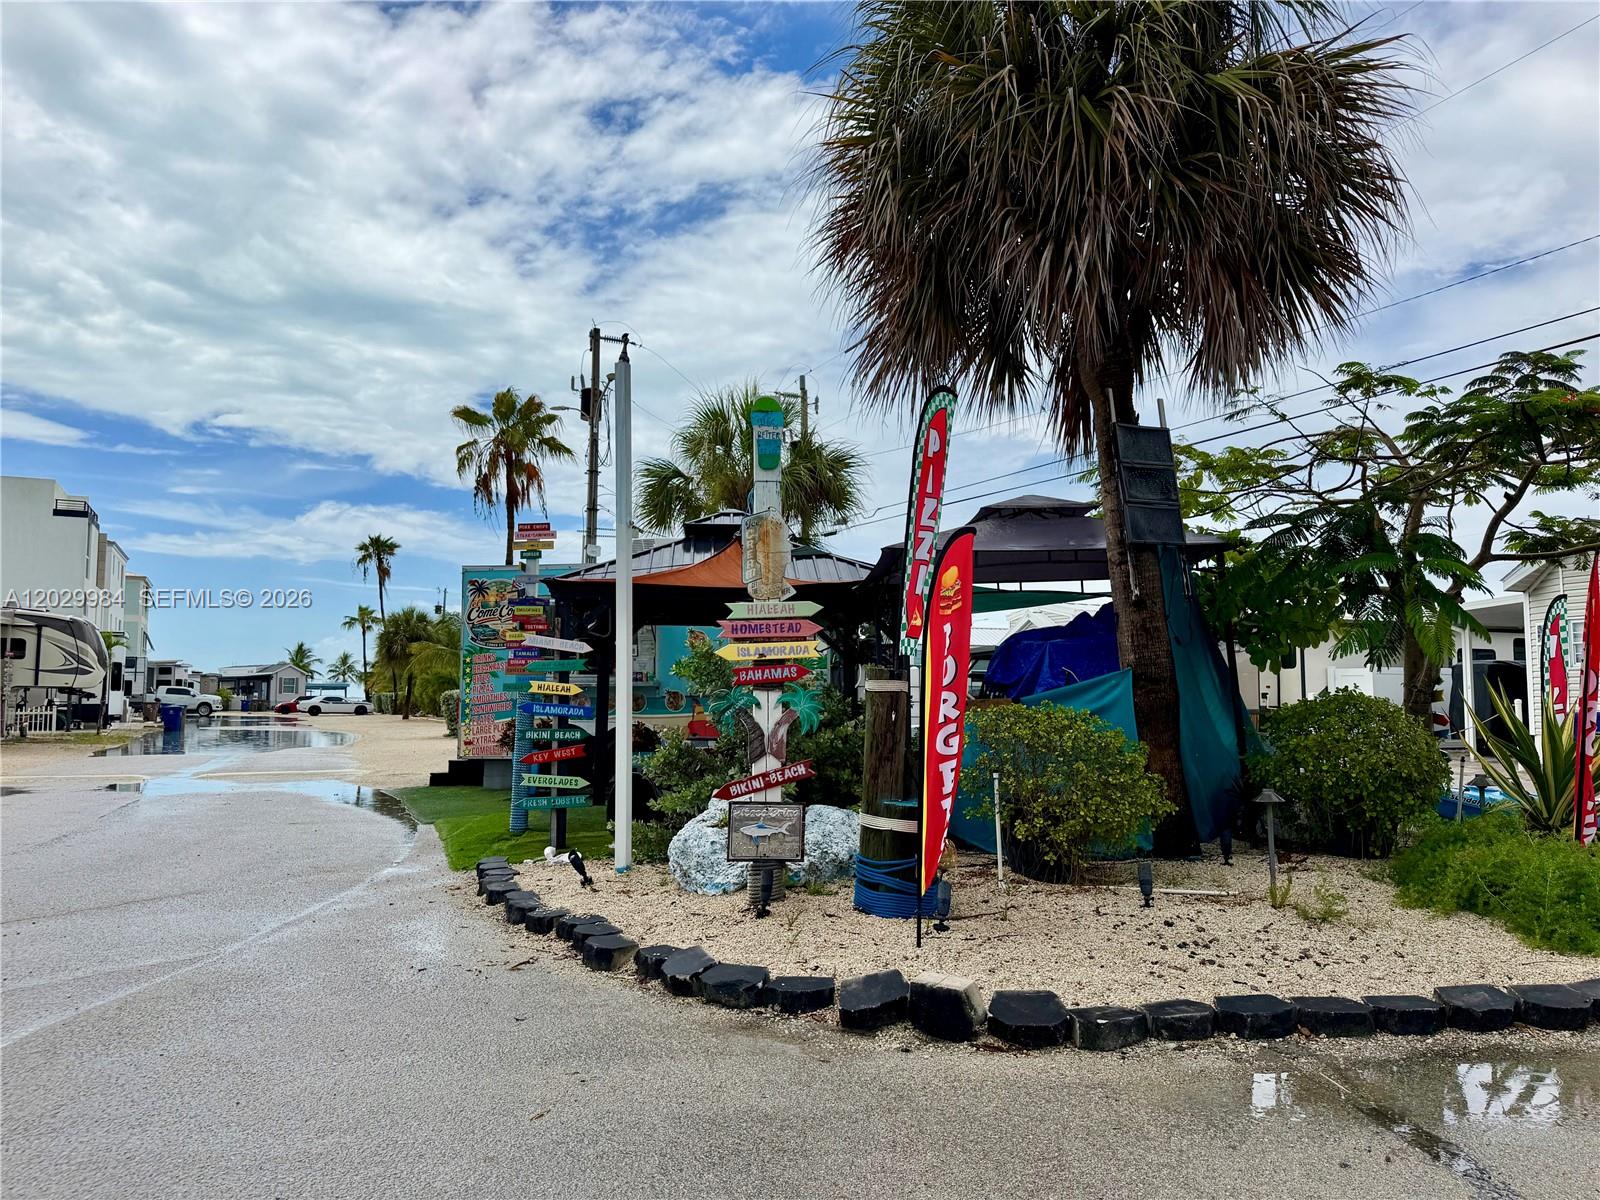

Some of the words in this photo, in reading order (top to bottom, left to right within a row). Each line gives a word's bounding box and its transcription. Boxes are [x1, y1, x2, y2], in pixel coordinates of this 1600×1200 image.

[467, 607, 498, 622] Come
[498, 605, 515, 618] Co
[746, 603, 796, 616] HIALEAH
[730, 622, 802, 635] HOMESTEAD
[559, 641, 585, 651] BEACH
[736, 644, 810, 658] ISLAMORADA
[739, 667, 798, 681] BAHAMAS
[537, 683, 571, 693] HIALEAH
[532, 704, 585, 716] ISLAMORADA
[471, 724, 493, 736] LARGE
[525, 730, 551, 740] BIKINI
[554, 730, 581, 740] BEACH
[471, 735, 497, 746] EXTRAS
[532, 751, 549, 761] KEY
[553, 748, 577, 759] WEST
[527, 776, 579, 787] EVERGLADES
[522, 798, 548, 807] FRESH
